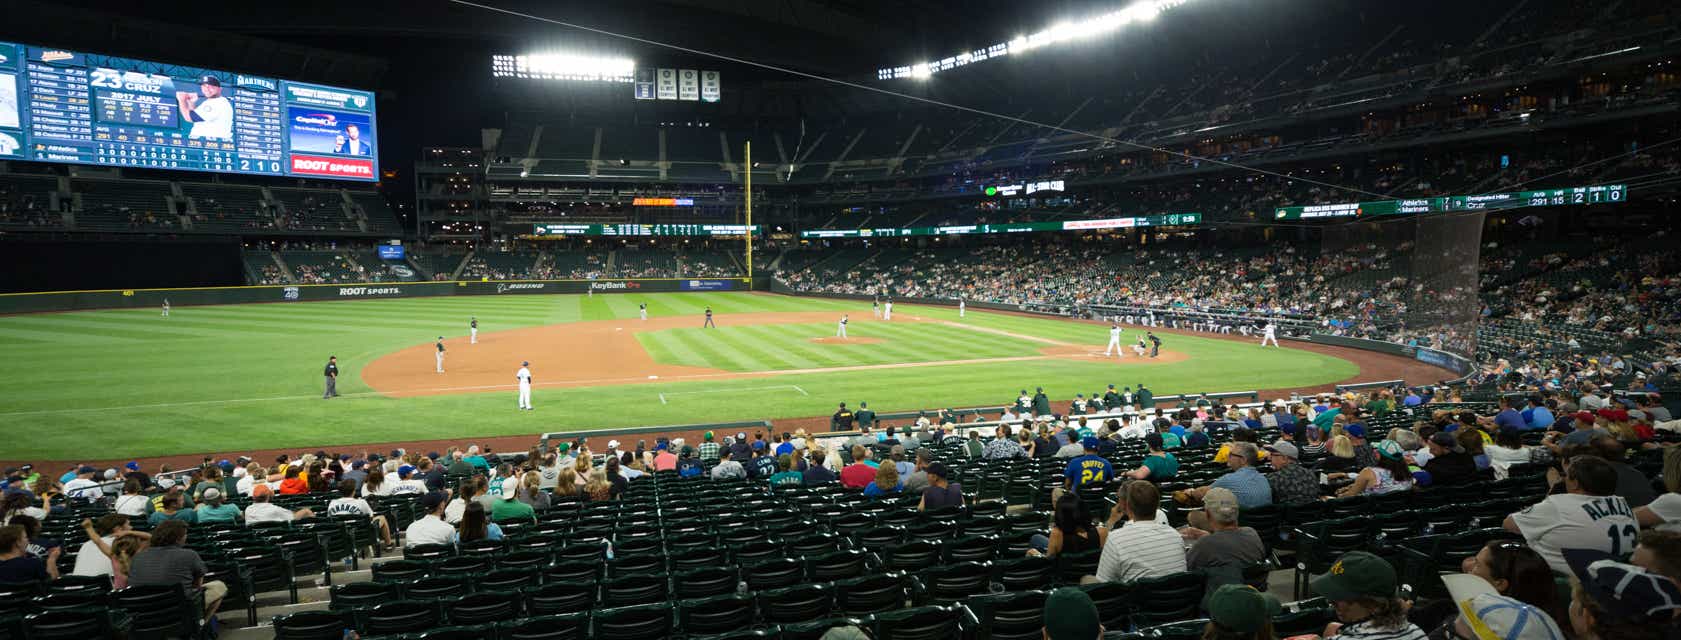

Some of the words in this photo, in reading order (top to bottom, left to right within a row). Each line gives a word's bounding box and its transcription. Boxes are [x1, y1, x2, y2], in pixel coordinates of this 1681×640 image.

[90, 71, 122, 89] 23
[125, 83, 161, 94] CRUZ
[111, 92, 135, 100] 2017
[137, 95, 161, 104] JULY
[241, 160, 250, 170] 2
[271, 162, 280, 172] 0
[294, 159, 329, 171] ROOT
[1575, 193, 1583, 203] 2
[1593, 192, 1599, 201] 1
[1611, 190, 1619, 200] 0
[339, 287, 366, 296] ROOT
[592, 281, 626, 290] KeyBank
[1081, 469, 1104, 484] 24
[1608, 524, 1637, 555] 13
